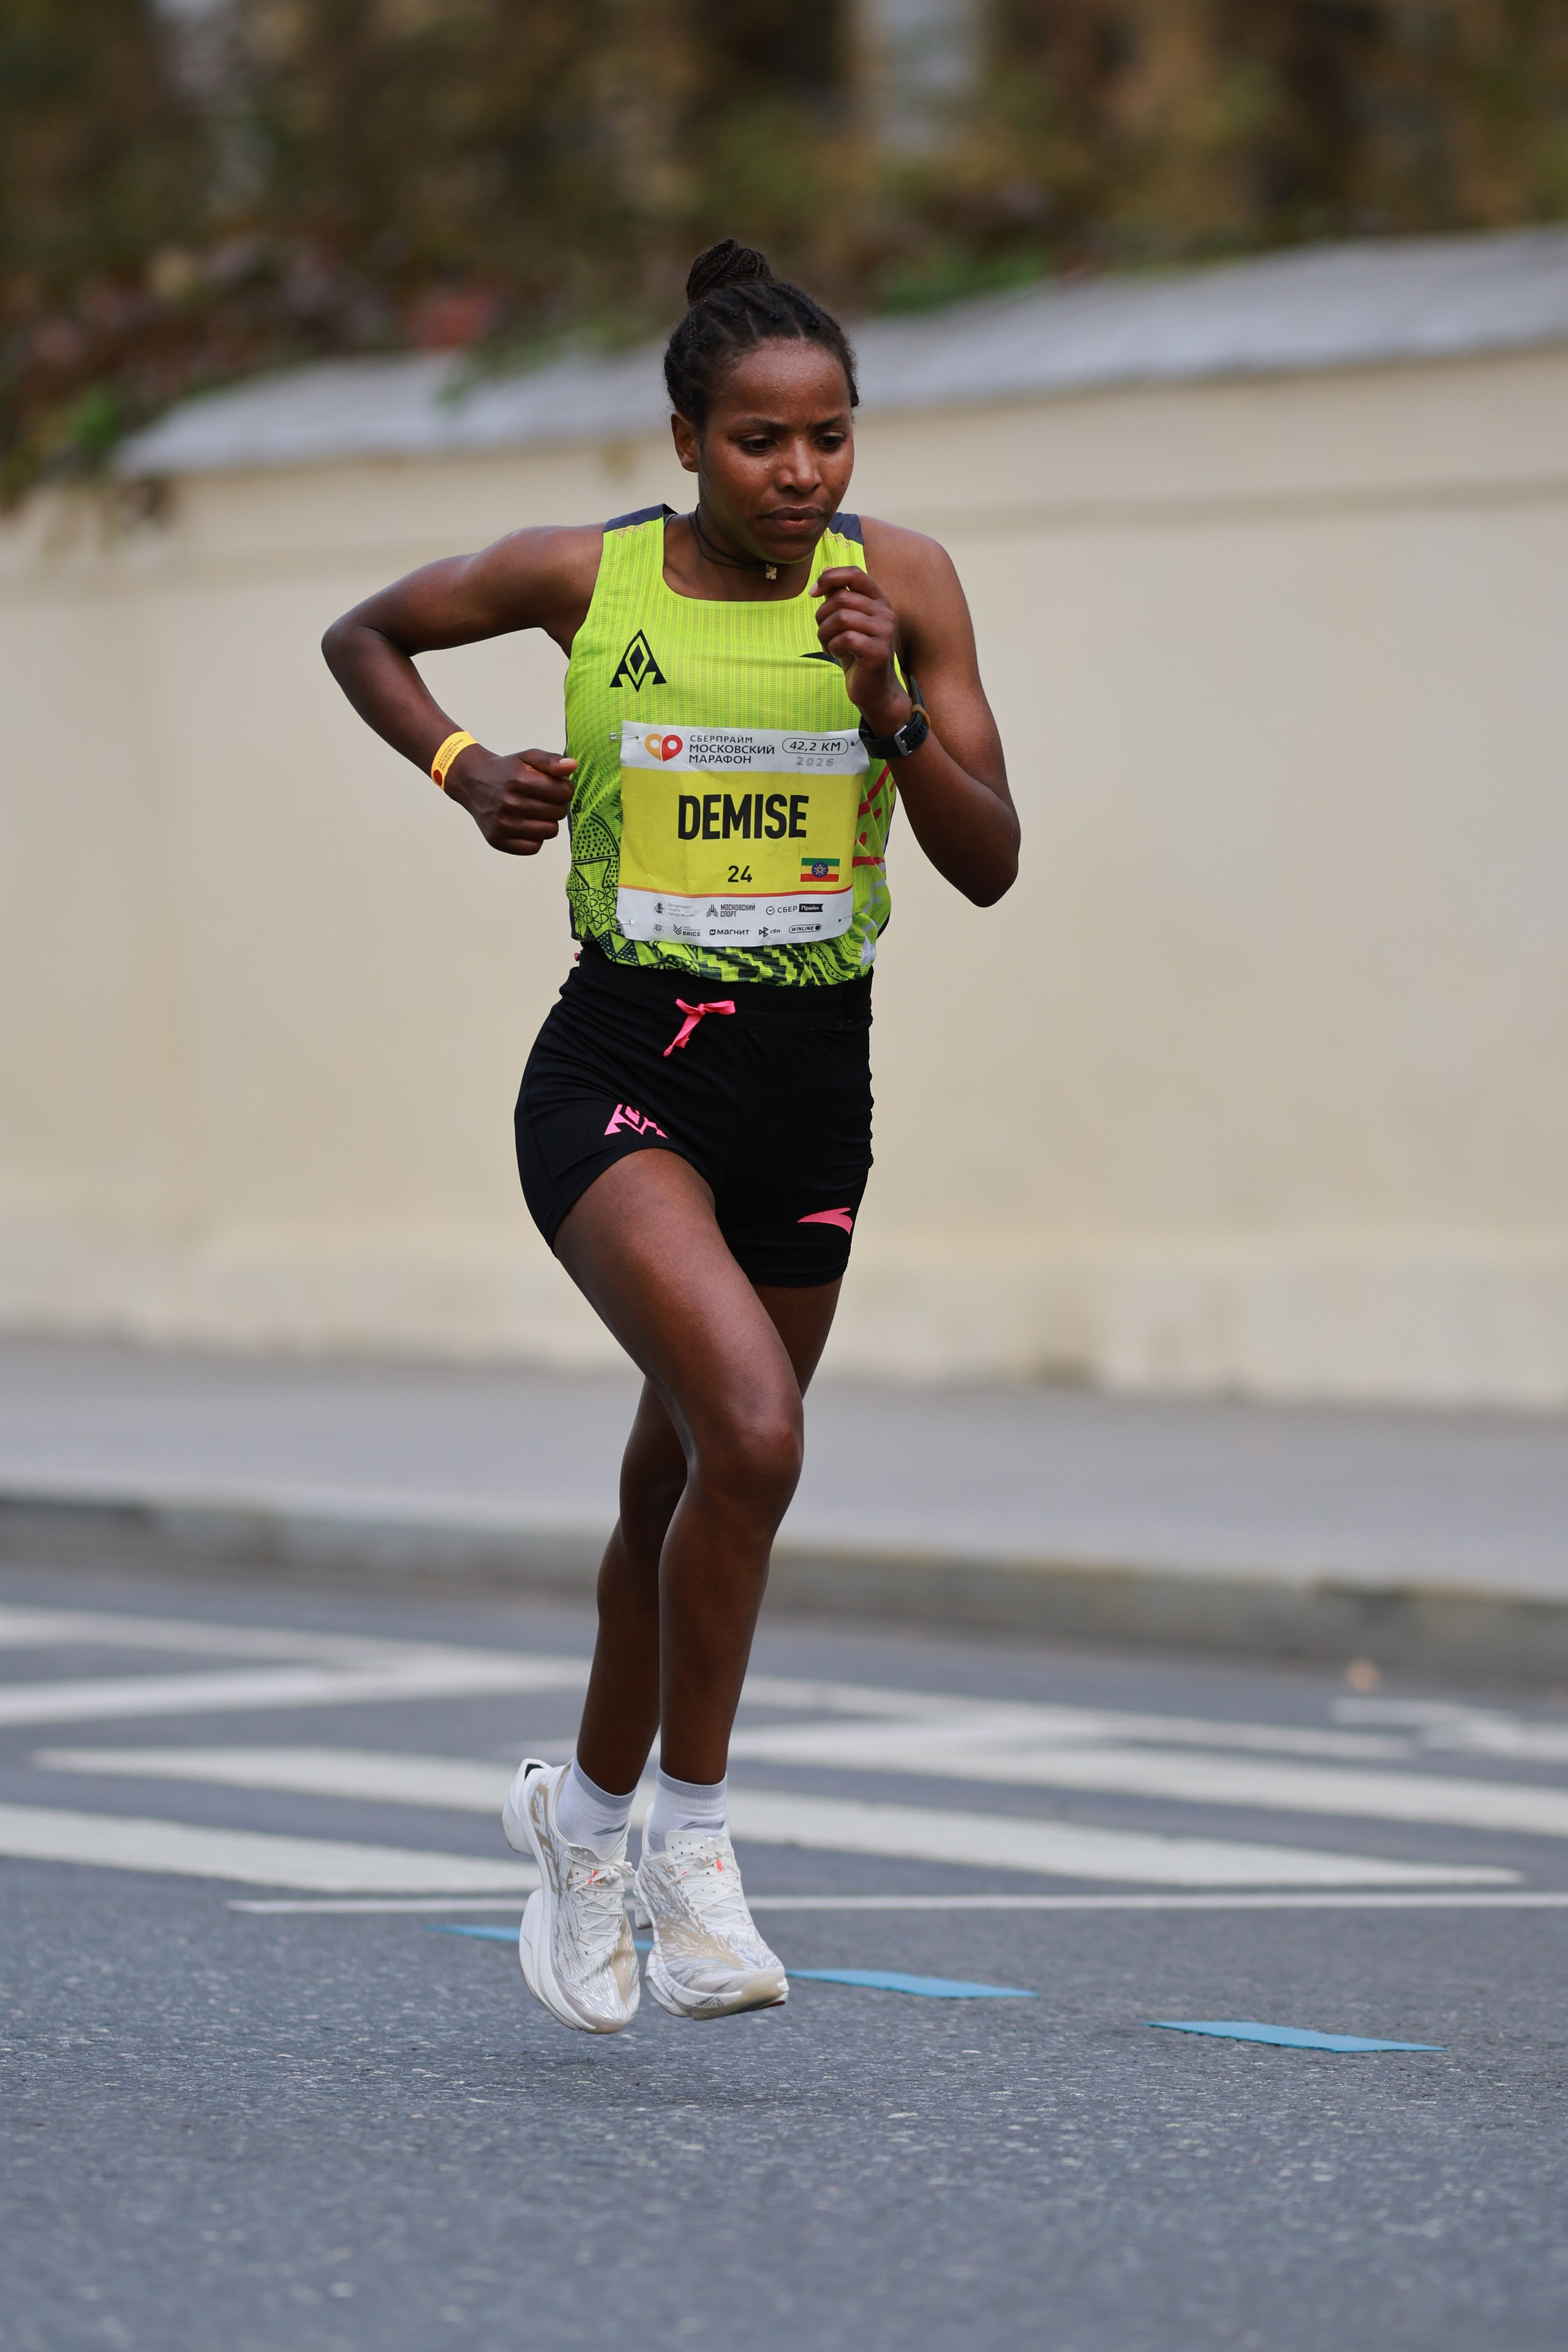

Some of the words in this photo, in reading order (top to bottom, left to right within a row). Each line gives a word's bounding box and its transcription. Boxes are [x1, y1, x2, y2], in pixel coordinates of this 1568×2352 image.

[690, 744, 775, 755] МОСКОВСКИЙ
[790, 741, 816, 752] 42,2
[439, 739, 464, 769] МОСКОВСКИЙ
[442, 747, 459, 771] МАРАФОН
[689, 755, 752, 764] МАРАФОН
[796, 756, 834, 767] 2026
[678, 794, 809, 840] DEMISE
[728, 865, 752, 883] 24
